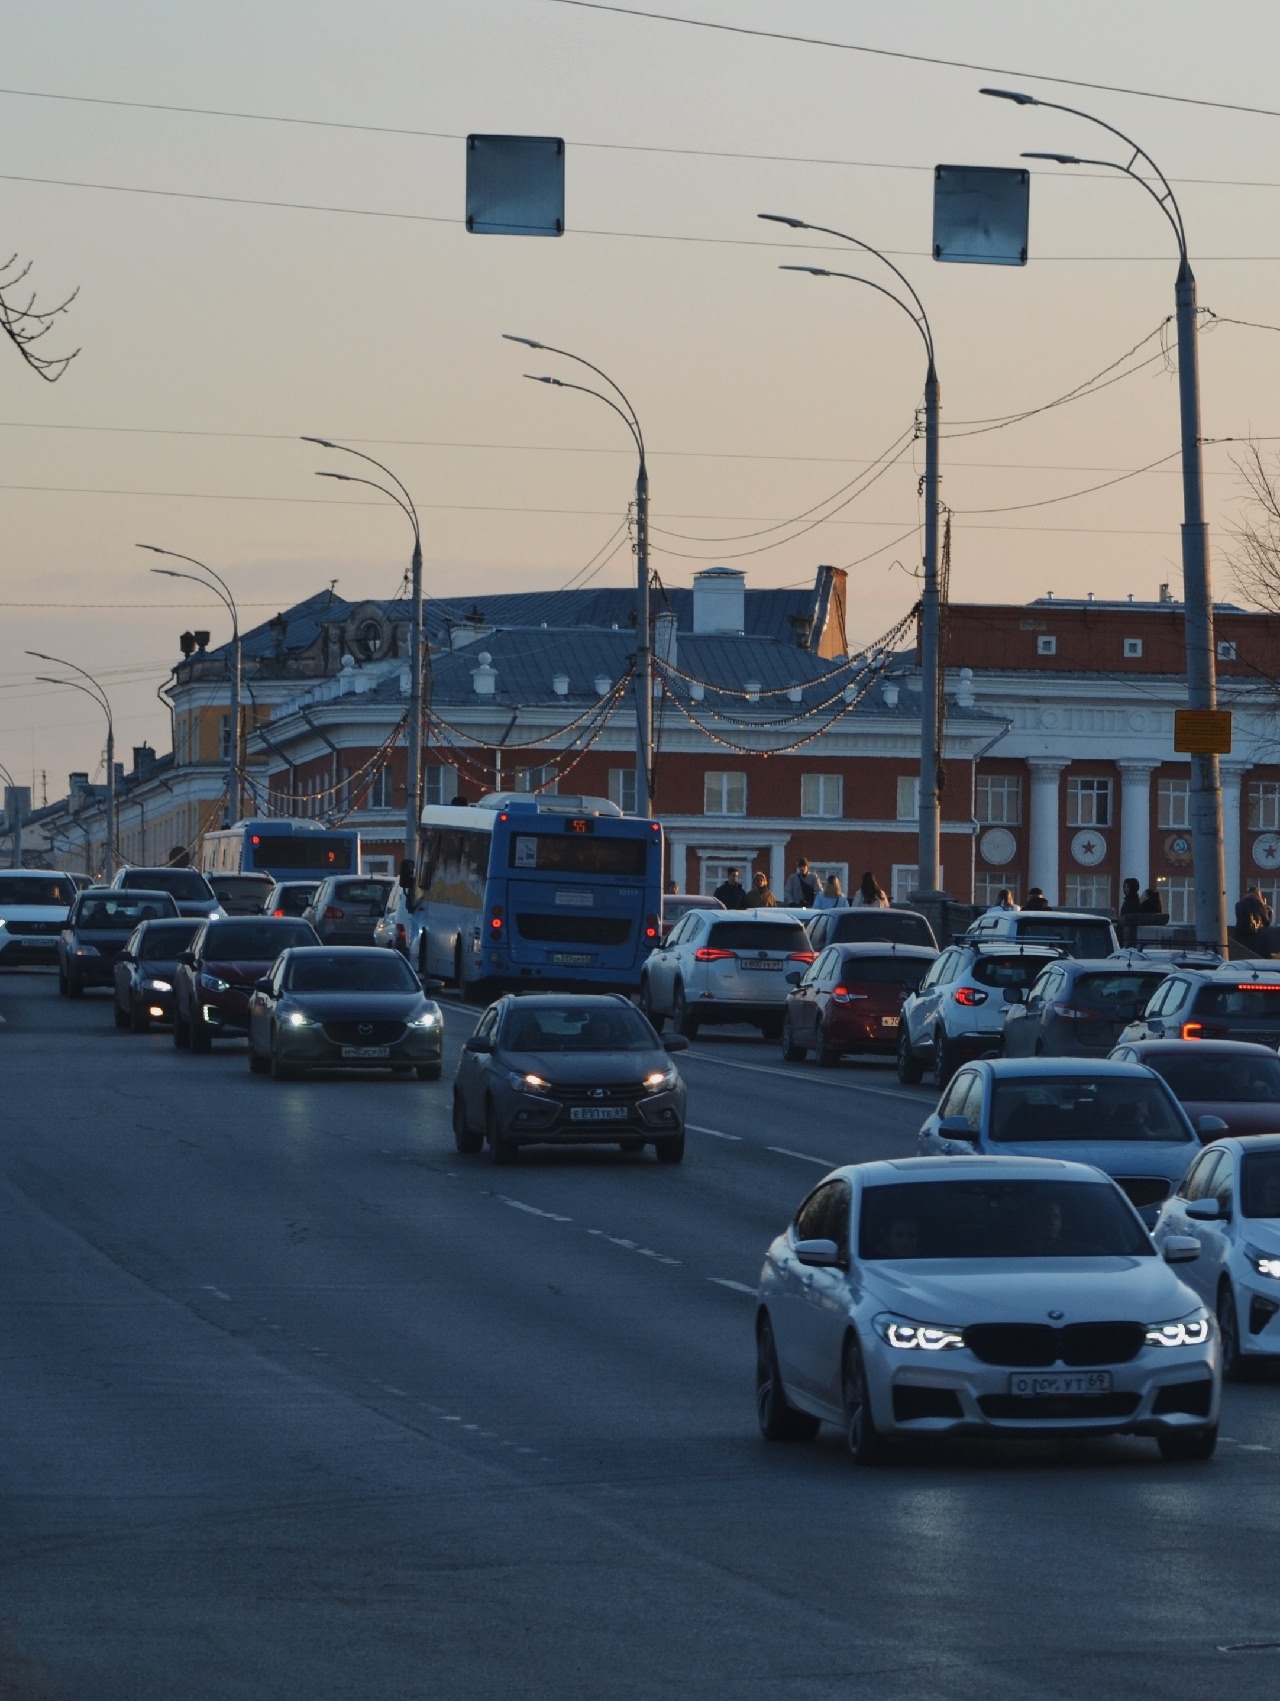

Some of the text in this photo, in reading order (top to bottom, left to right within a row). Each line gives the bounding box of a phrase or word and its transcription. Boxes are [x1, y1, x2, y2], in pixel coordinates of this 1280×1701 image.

[573, 819, 586, 833] 55
[328, 852, 335, 862] 9
[1087, 1373, 1106, 1387] 69
